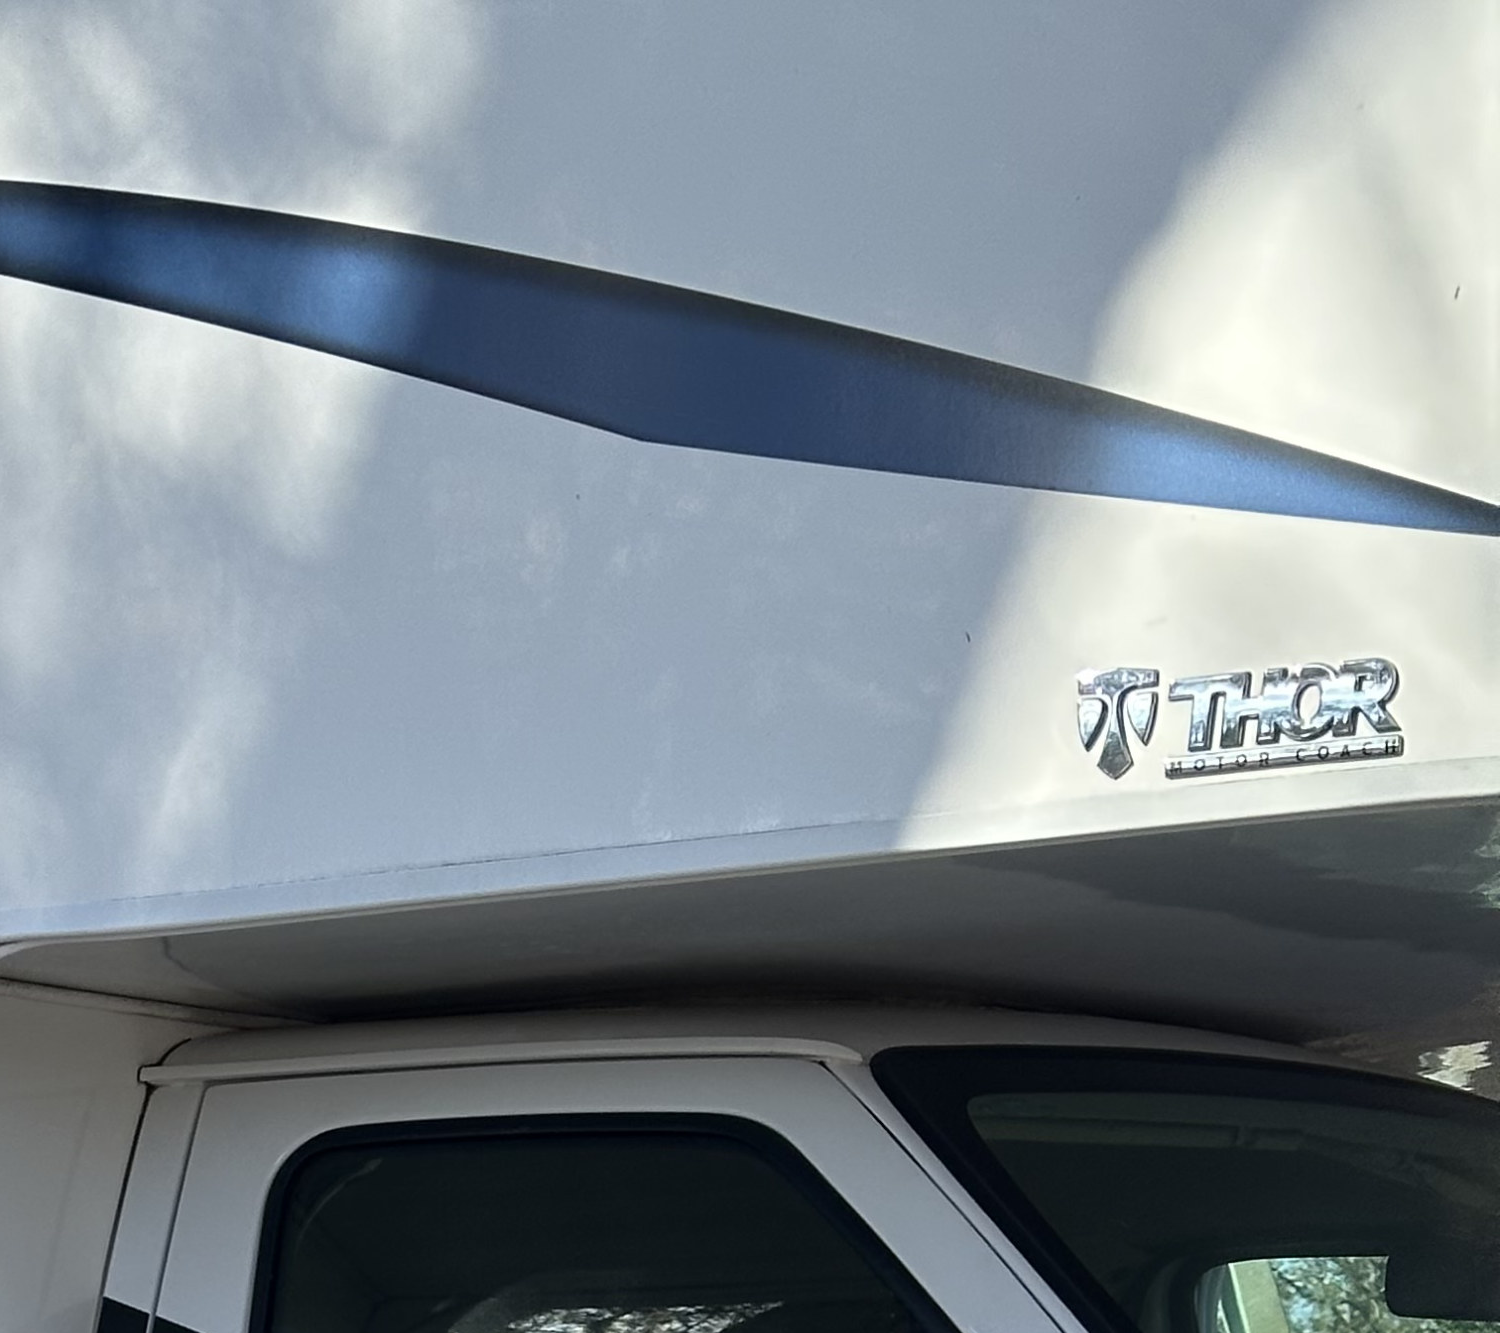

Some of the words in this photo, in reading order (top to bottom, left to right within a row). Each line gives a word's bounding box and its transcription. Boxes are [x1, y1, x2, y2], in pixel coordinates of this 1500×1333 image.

[1168, 657, 1403, 752] THOR
[1168, 752, 1270, 775] MOTOR
[1295, 740, 1399, 762] COACH
